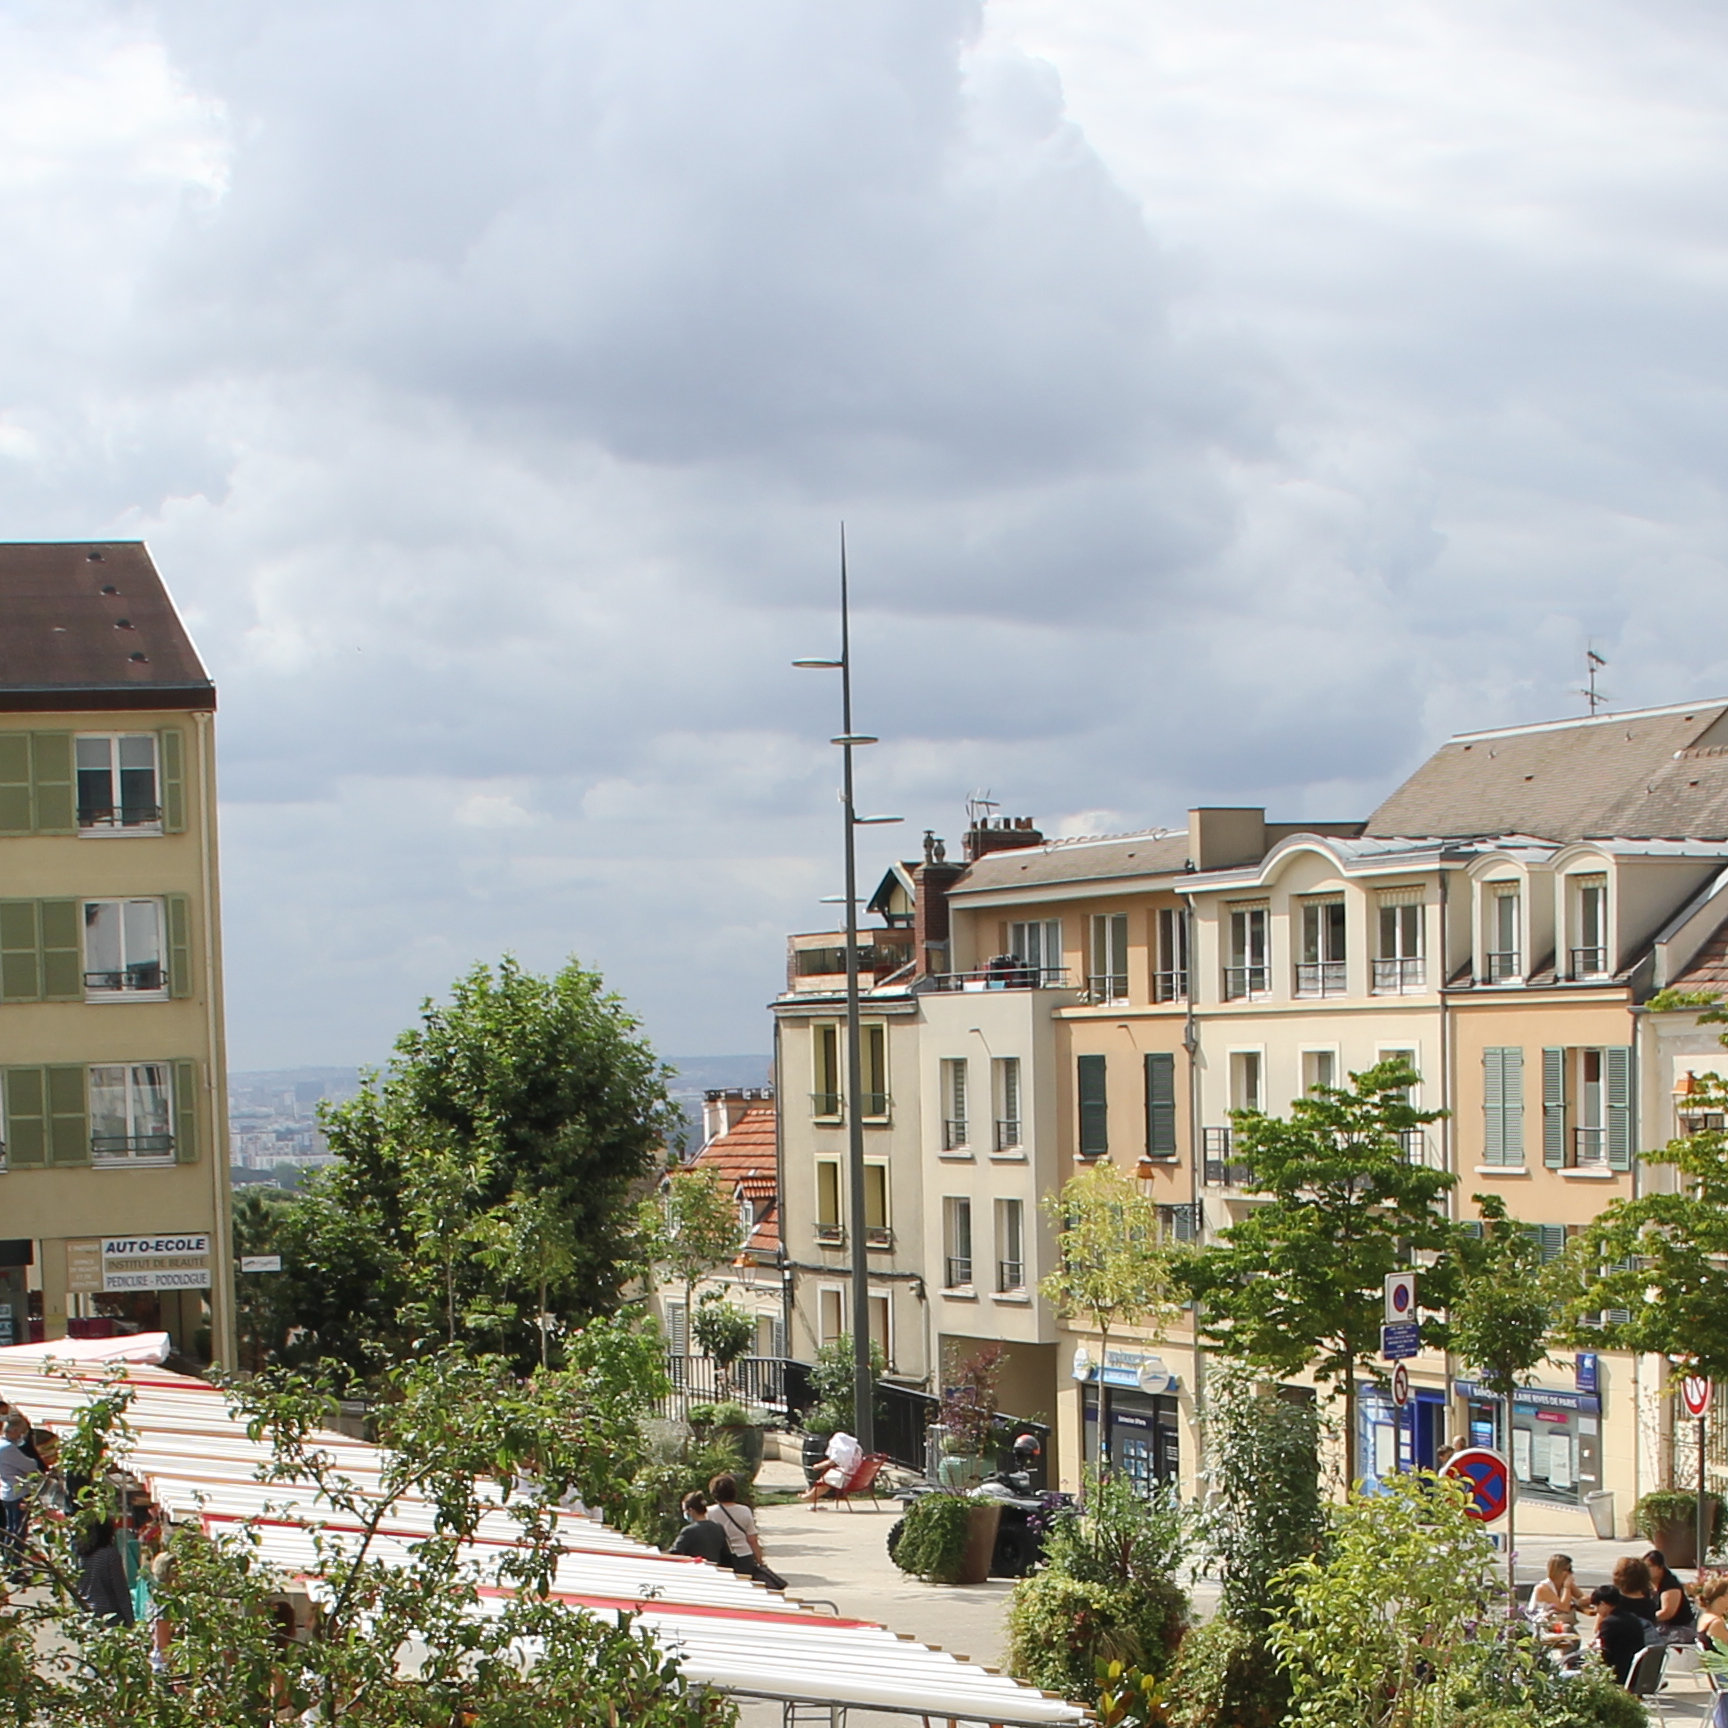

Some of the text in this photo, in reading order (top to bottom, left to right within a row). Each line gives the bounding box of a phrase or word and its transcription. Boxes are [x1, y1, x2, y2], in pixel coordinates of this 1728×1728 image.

[105, 1238, 205, 1254] AUTO-ECOLE
[108, 1259, 150, 1270] INSTITUT
[153, 1258, 166, 1269] DE
[107, 1275, 148, 1288] PEDICURE
[155, 1272, 208, 1286] PODOLOGUE
[1473, 1387, 1499, 1399] BANQU
[1559, 1397, 1577, 1409] PARIS
